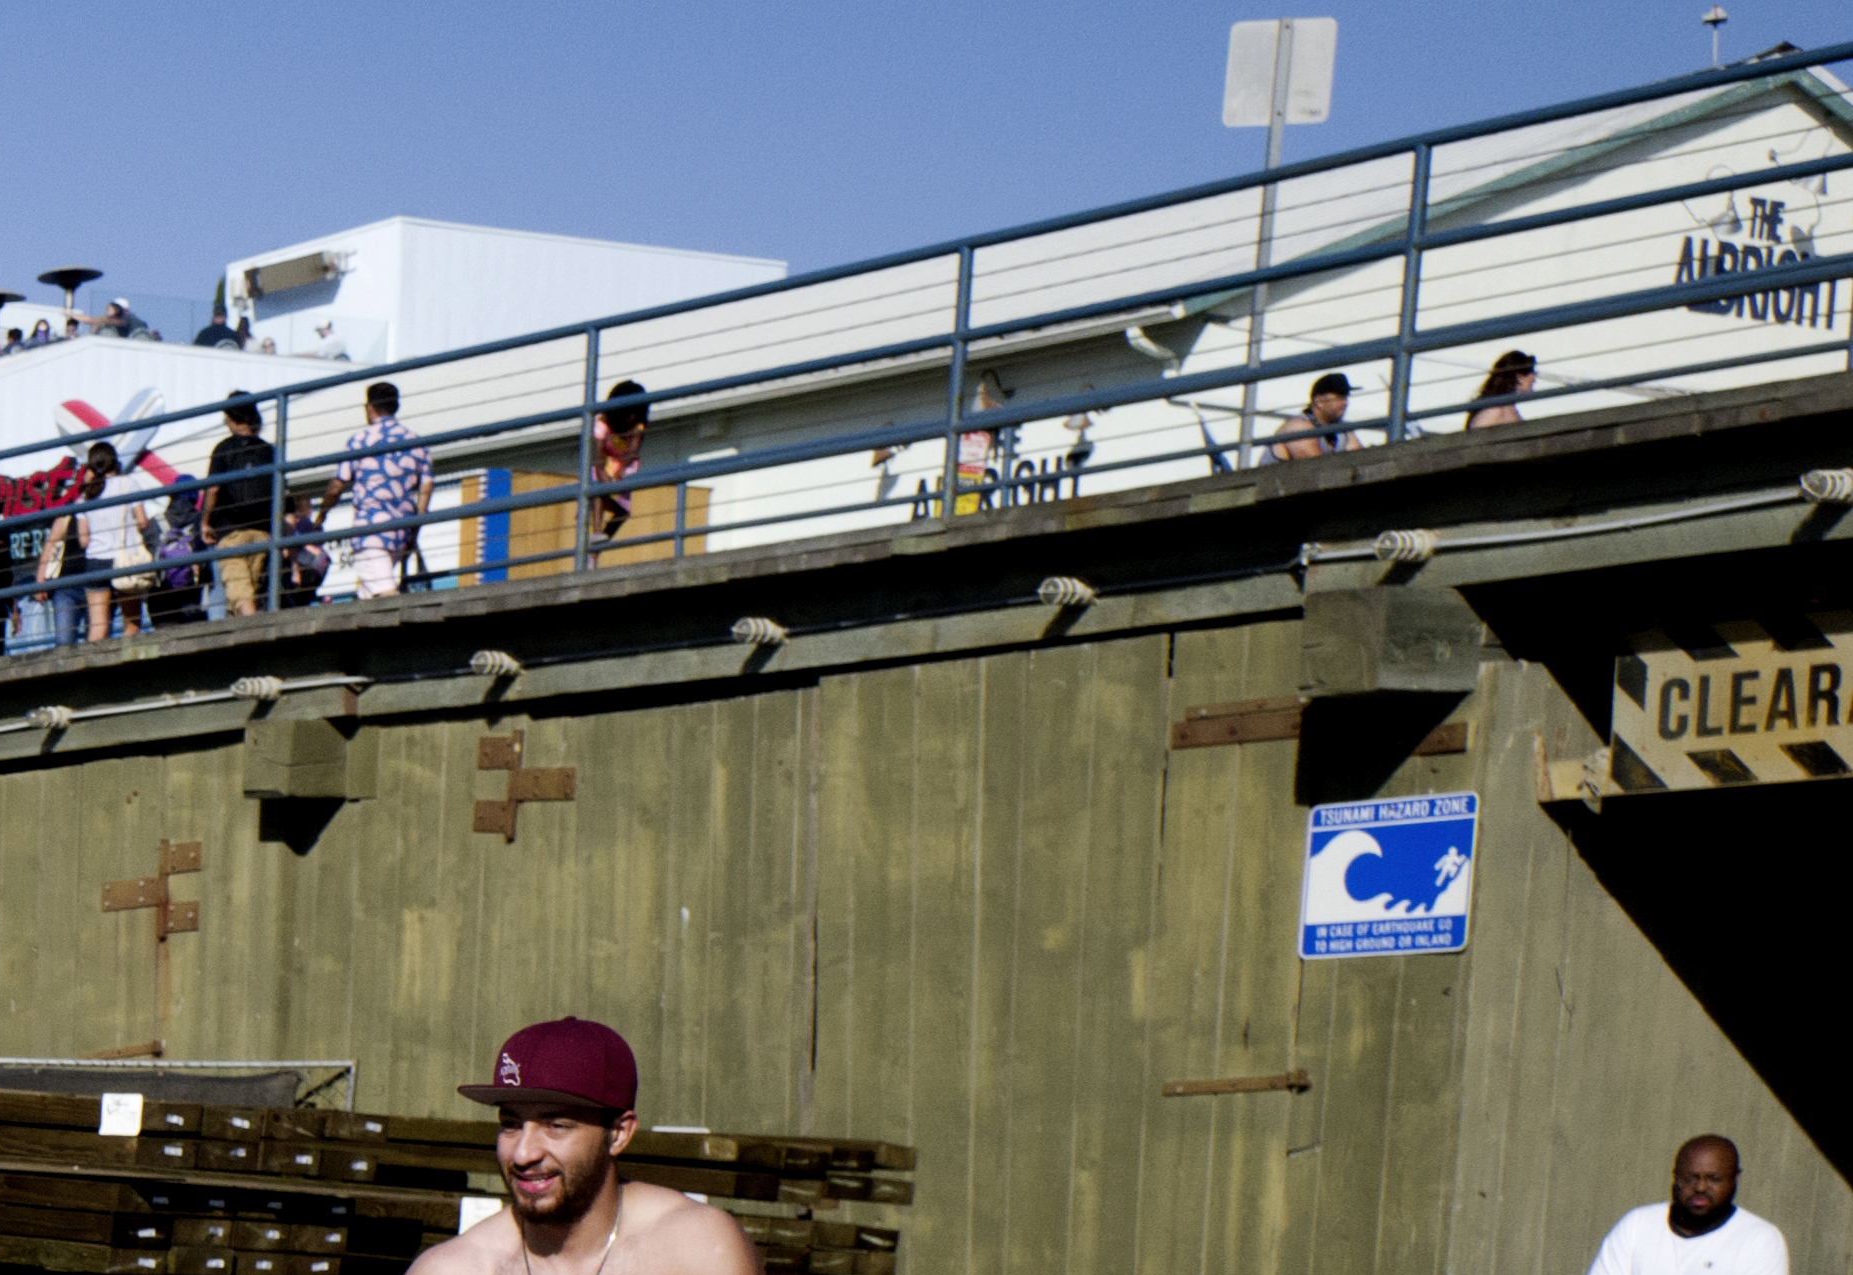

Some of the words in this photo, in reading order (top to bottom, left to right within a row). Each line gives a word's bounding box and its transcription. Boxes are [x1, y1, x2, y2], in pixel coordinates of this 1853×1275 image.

[1749, 198, 1785, 243] THE
[1658, 663, 1853, 741] CLEAR
[1320, 808, 1376, 826] TSUNAMI
[1378, 801, 1430, 820] HAZARD
[1433, 797, 1470, 815] ZONE
